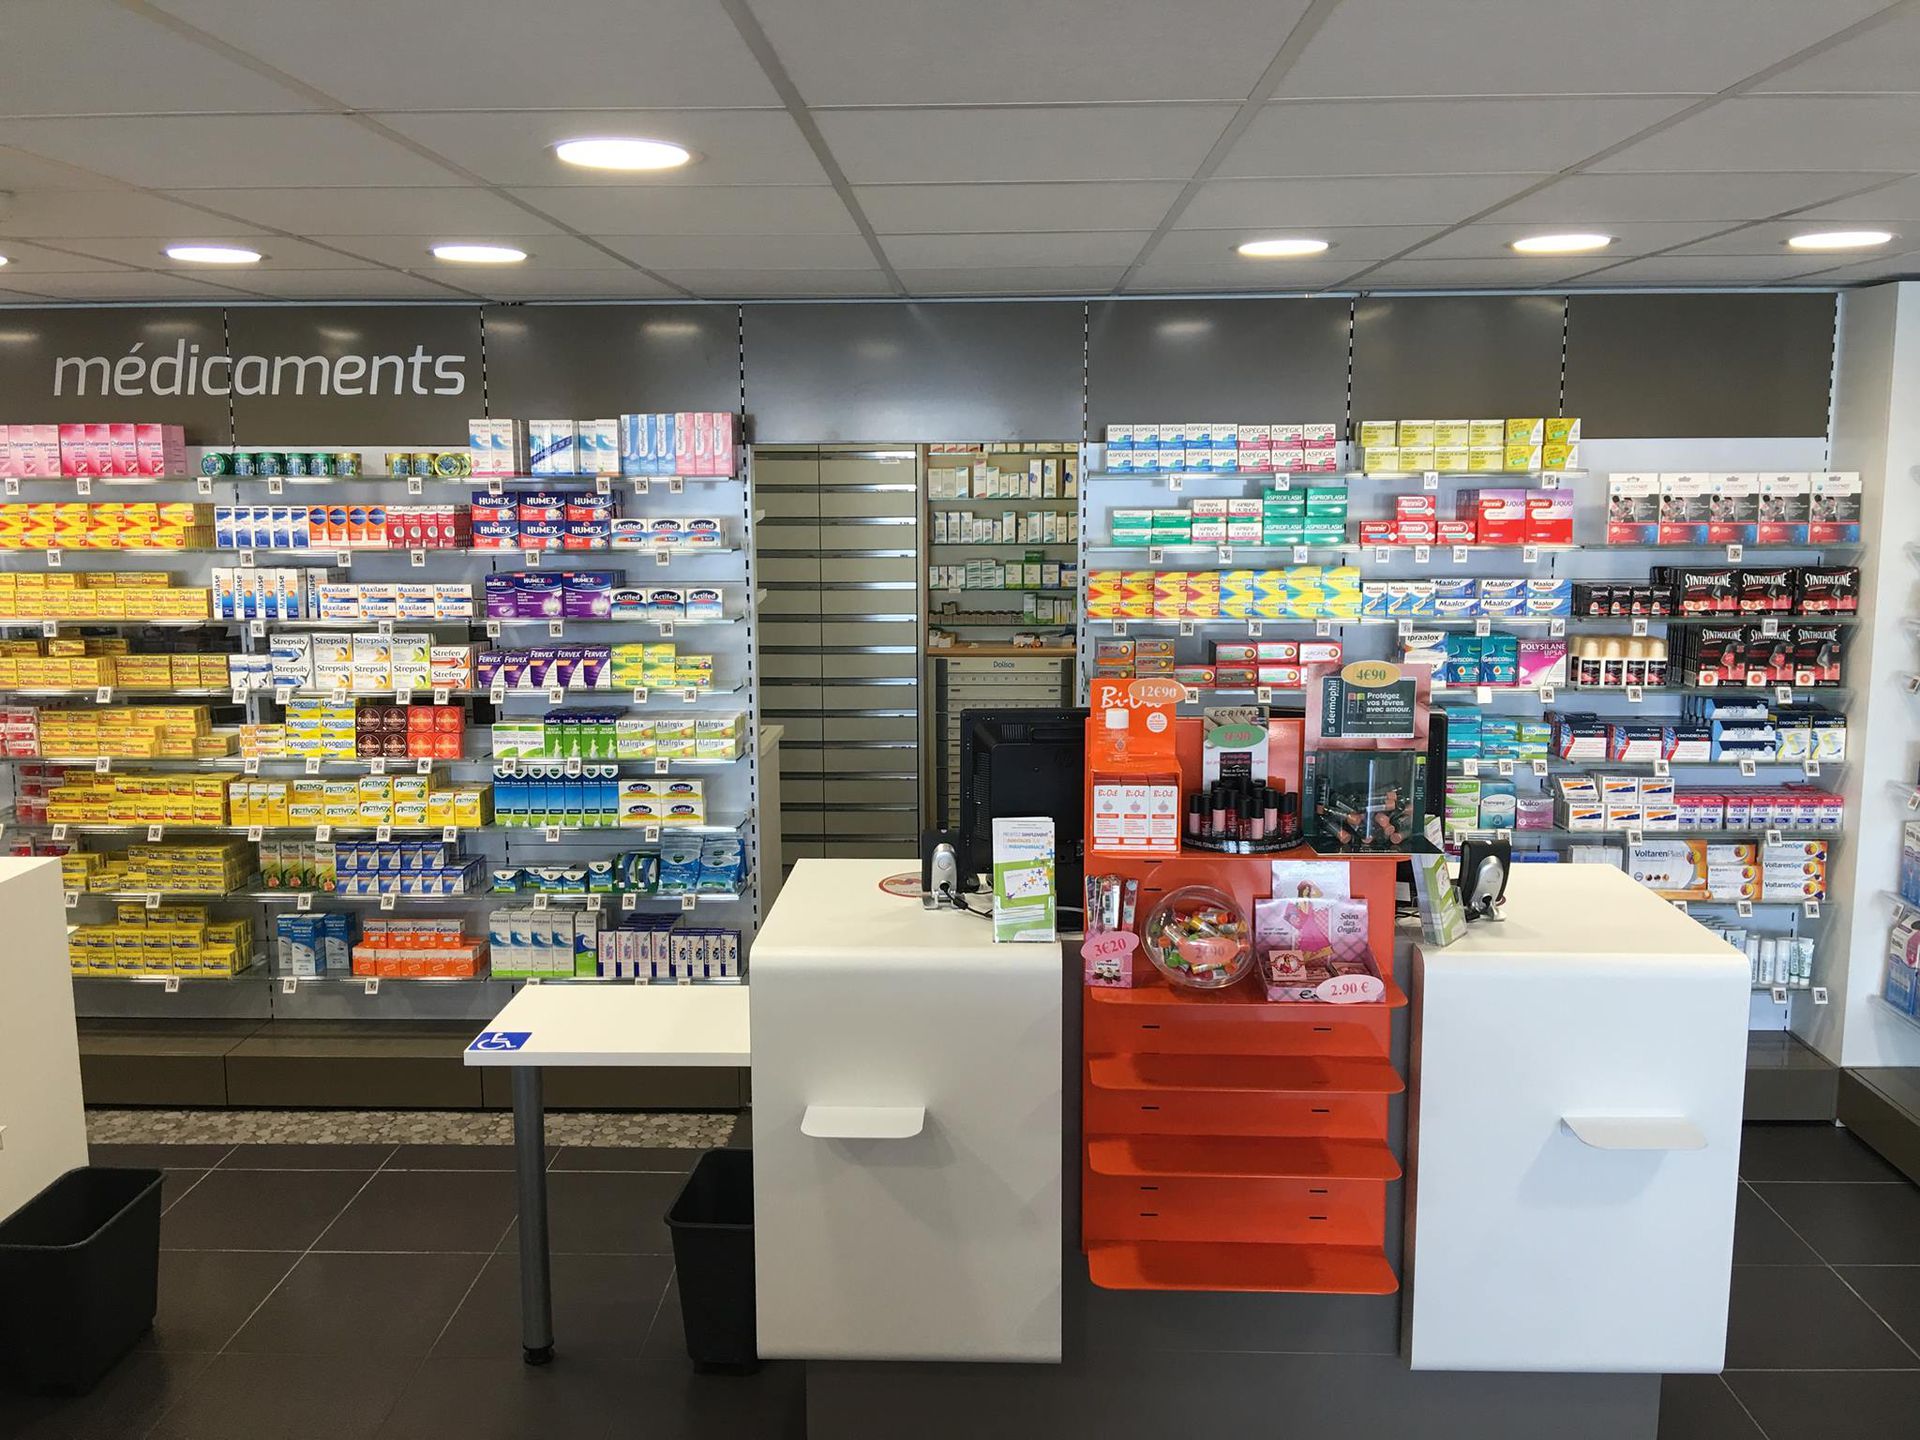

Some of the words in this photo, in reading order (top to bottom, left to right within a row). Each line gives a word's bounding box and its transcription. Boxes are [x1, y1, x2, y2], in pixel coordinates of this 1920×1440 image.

[53, 338, 466, 397] médicaments
[481, 526, 511, 534] HUMEX
[528, 526, 558, 534] HUMEX
[572, 526, 602, 534] HUMEX
[617, 522, 642, 530] Actifed
[654, 522, 678, 530] Actifed
[690, 521, 715, 530] Actifed
[616, 592, 640, 601] Actifed
[654, 592, 678, 601] Actifed
[692, 592, 716, 600] Actifed
[272, 636, 306, 646] Strepsils
[315, 636, 348, 646] Strepsils
[355, 636, 388, 646] Strepsils
[392, 636, 426, 646] Strepsils
[433, 649, 461, 657] Strefen
[530, 650, 554, 658] FERVEX
[558, 650, 581, 658] FERVEX
[584, 650, 608, 658] FERVEX
[478, 655, 502, 664] FERVEX
[504, 656, 528, 664] FERVEX
[274, 664, 307, 674] Strepsils
[317, 664, 350, 674] Strepsils
[354, 664, 388, 674] Strepsils
[394, 664, 426, 674] Strepsils
[433, 670, 462, 678] Strefen
[1356, 669, 1386, 680] 4€90
[1140, 686, 1177, 698] 12€90
[1367, 692, 1400, 701] Protégez
[1328, 680, 1338, 724] dermophil
[618, 722, 644, 730] Alairgix
[656, 721, 684, 729] Alairgix
[698, 720, 724, 728] Alairgix
[619, 740, 645, 748] Alairgix
[658, 740, 684, 748] Alairgix
[698, 739, 724, 748] Alairgix
[1340, 912, 1359, 920] Soins
[1337, 926, 1362, 934] Ongles
[1094, 938, 1127, 958] 3€20
[1330, 982, 1358, 996] 2.90
[1360, 982, 1370, 993] €
